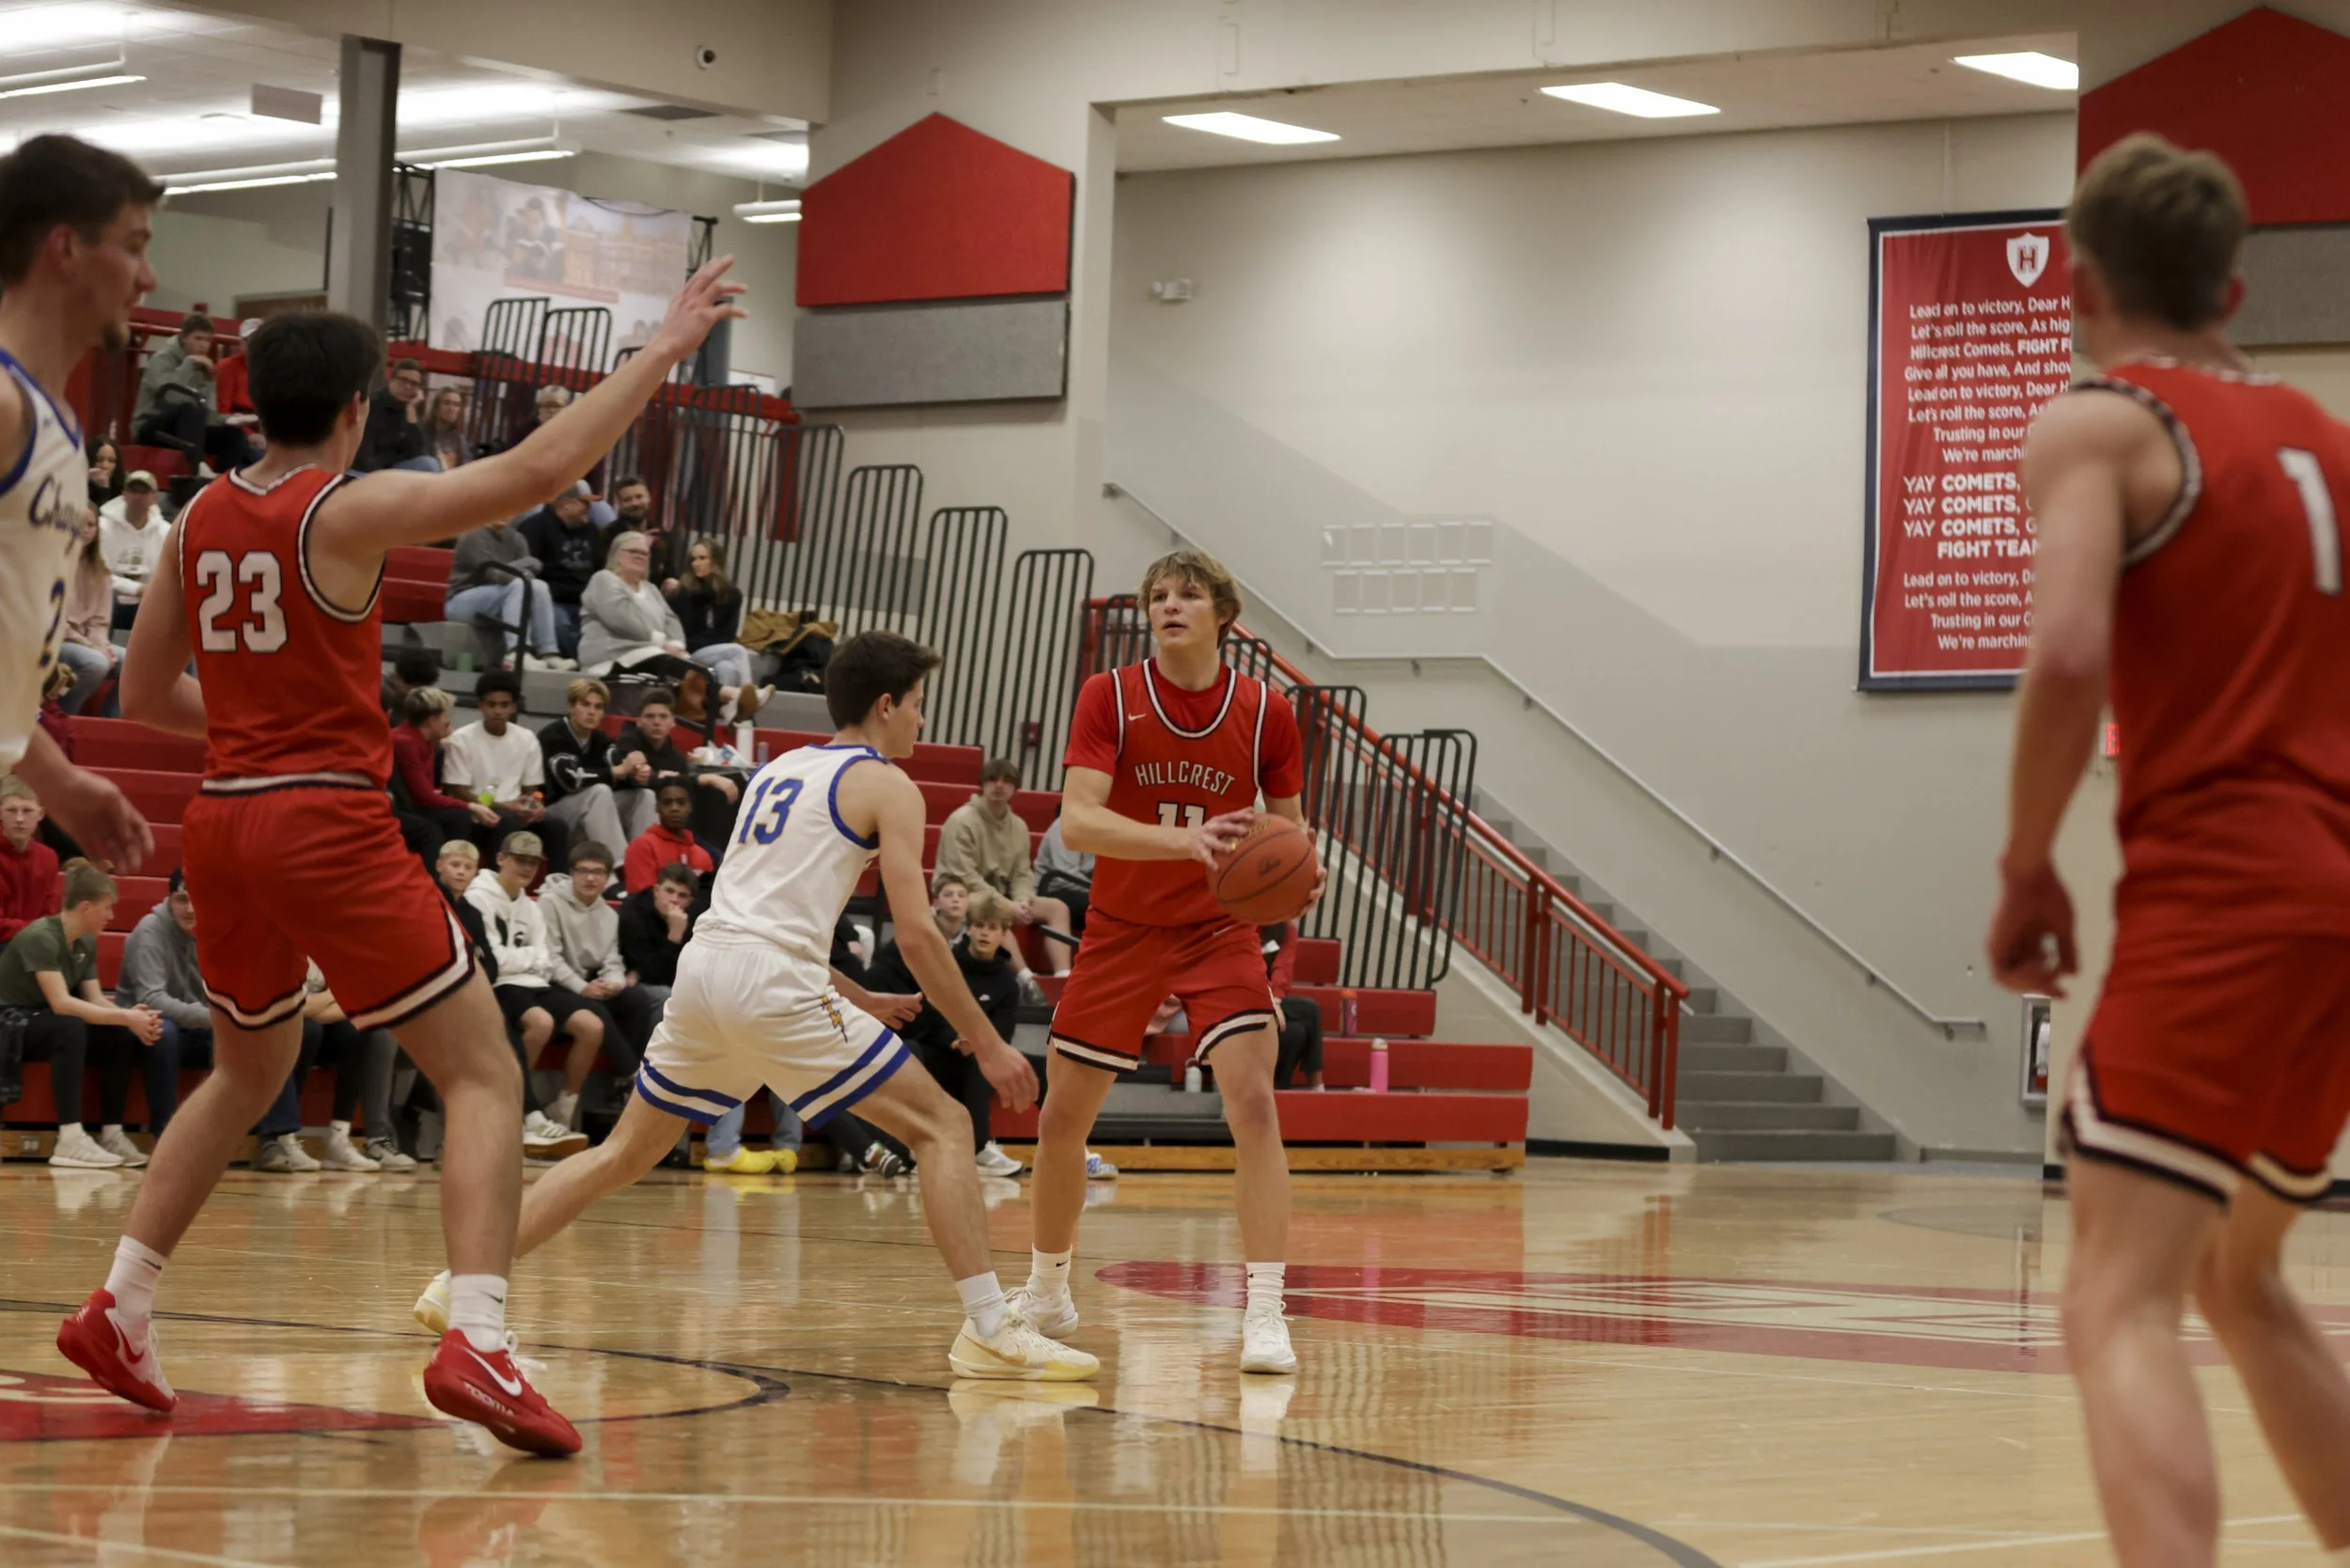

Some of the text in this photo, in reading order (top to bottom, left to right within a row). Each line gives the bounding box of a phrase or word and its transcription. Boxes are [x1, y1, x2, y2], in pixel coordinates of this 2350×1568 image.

[2016, 244, 2038, 274] H
[1910, 302, 1940, 319] Lead
[1944, 303, 1958, 317] on
[1962, 301, 1975, 316] to
[1978, 298, 2025, 316] victory,
[2029, 296, 2058, 313] Dear
[1911, 316, 2070, 339] Let's roll the score, As hig
[1911, 343, 1960, 360] Hillcrest
[1964, 340, 2013, 358] Comets,
[2017, 337, 2058, 354] FIGHT
[1904, 366, 1933, 382] Give
[1935, 364, 1948, 380] all
[1951, 365, 1974, 382] you
[1977, 361, 2011, 378] have,
[2013, 360, 2041, 376] And
[1908, 386, 1938, 402] Lead
[1939, 386, 1957, 400] on
[1960, 384, 1973, 400] to
[1976, 382, 2023, 400] victory,
[2026, 380, 2057, 397] Dear
[1908, 407, 1937, 423] Let's
[1940, 405, 1963, 421] roll
[1965, 404, 1985, 420] the
[1988, 402, 2026, 420] score,
[1933, 426, 1985, 444] Trusting
[1989, 424, 2000, 440] in
[2002, 425, 2025, 440] our
[1942, 444, 2027, 463] We're marchi
[1903, 472, 2021, 494] YAY COMETS,
[1903, 496, 1936, 516] YAY
[1941, 494, 2021, 515] COMETS,
[1903, 519, 1936, 538] YAY
[1940, 516, 2020, 537] COMETS,
[2279, 447, 2342, 595] 1
[1937, 540, 1991, 559] FIGHT
[1904, 572, 1935, 588] Lead
[1937, 572, 1952, 587] on
[1955, 571, 1969, 587] to
[1972, 569, 2019, 588] victory,
[196, 550, 289, 653] 23
[1904, 591, 1935, 609] Let's
[1937, 590, 1956, 607] roll
[1960, 590, 1982, 607] the
[1984, 591, 2022, 608] score,
[1932, 613, 1982, 631] Trusting
[1984, 612, 1996, 627] in
[1998, 613, 2022, 627] our
[1937, 631, 2033, 651] We're marchin
[1135, 760, 1235, 796] HILLCREST
[737, 776, 805, 845] 13
